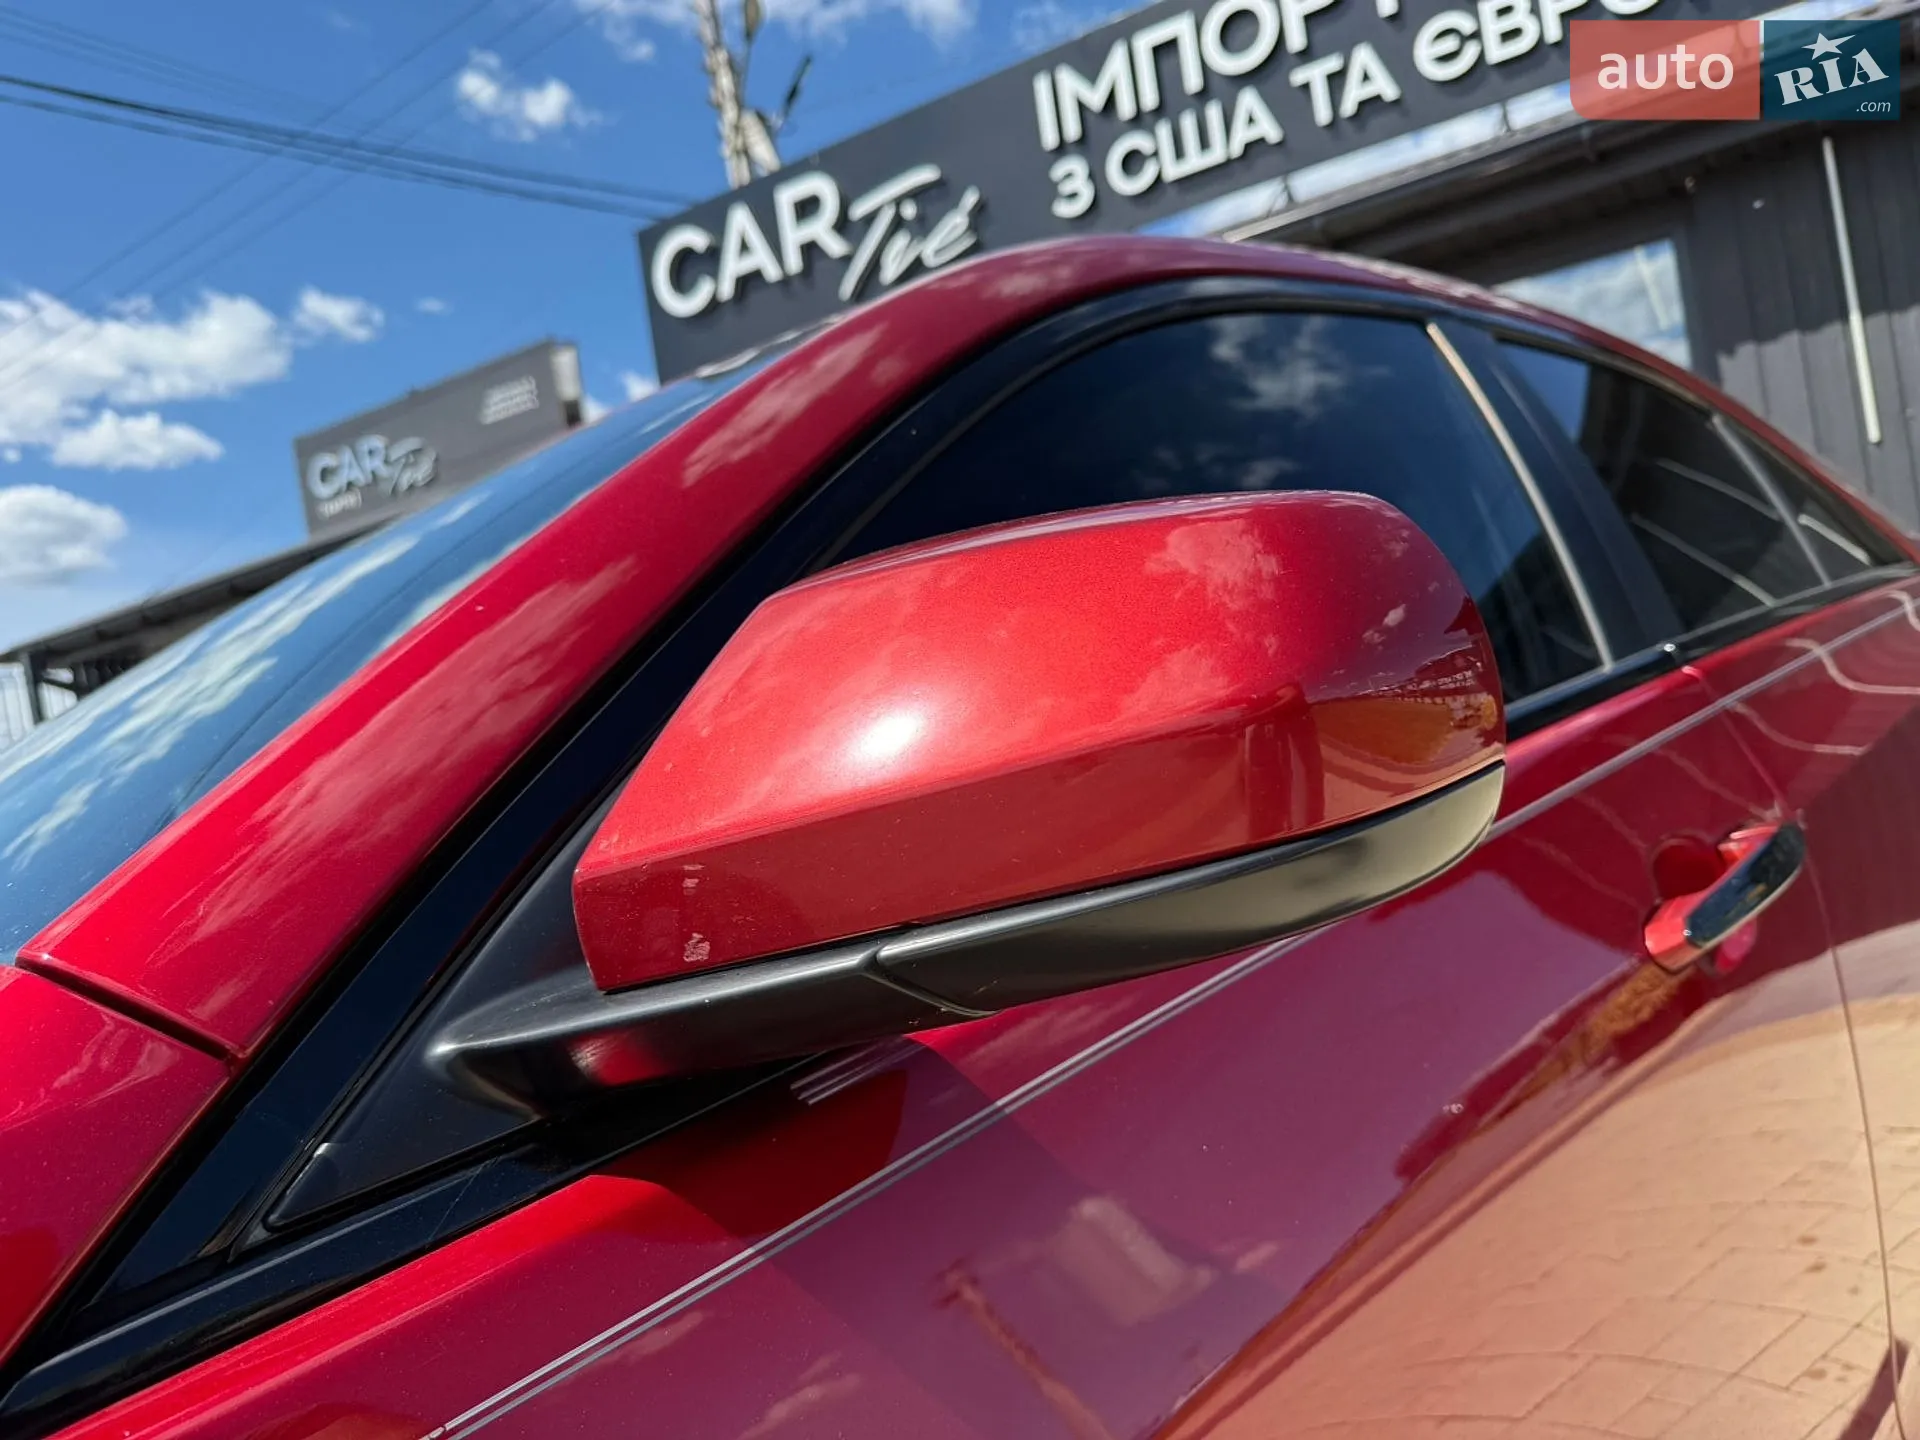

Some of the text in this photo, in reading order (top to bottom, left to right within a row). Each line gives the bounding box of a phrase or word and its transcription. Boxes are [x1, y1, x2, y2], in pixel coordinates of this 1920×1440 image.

[1032, 0, 1399, 151] ІМПОР
[1104, 85, 1284, 196] США
[1288, 41, 1402, 127] ТА
[1412, 0, 1660, 82] ЄВР
